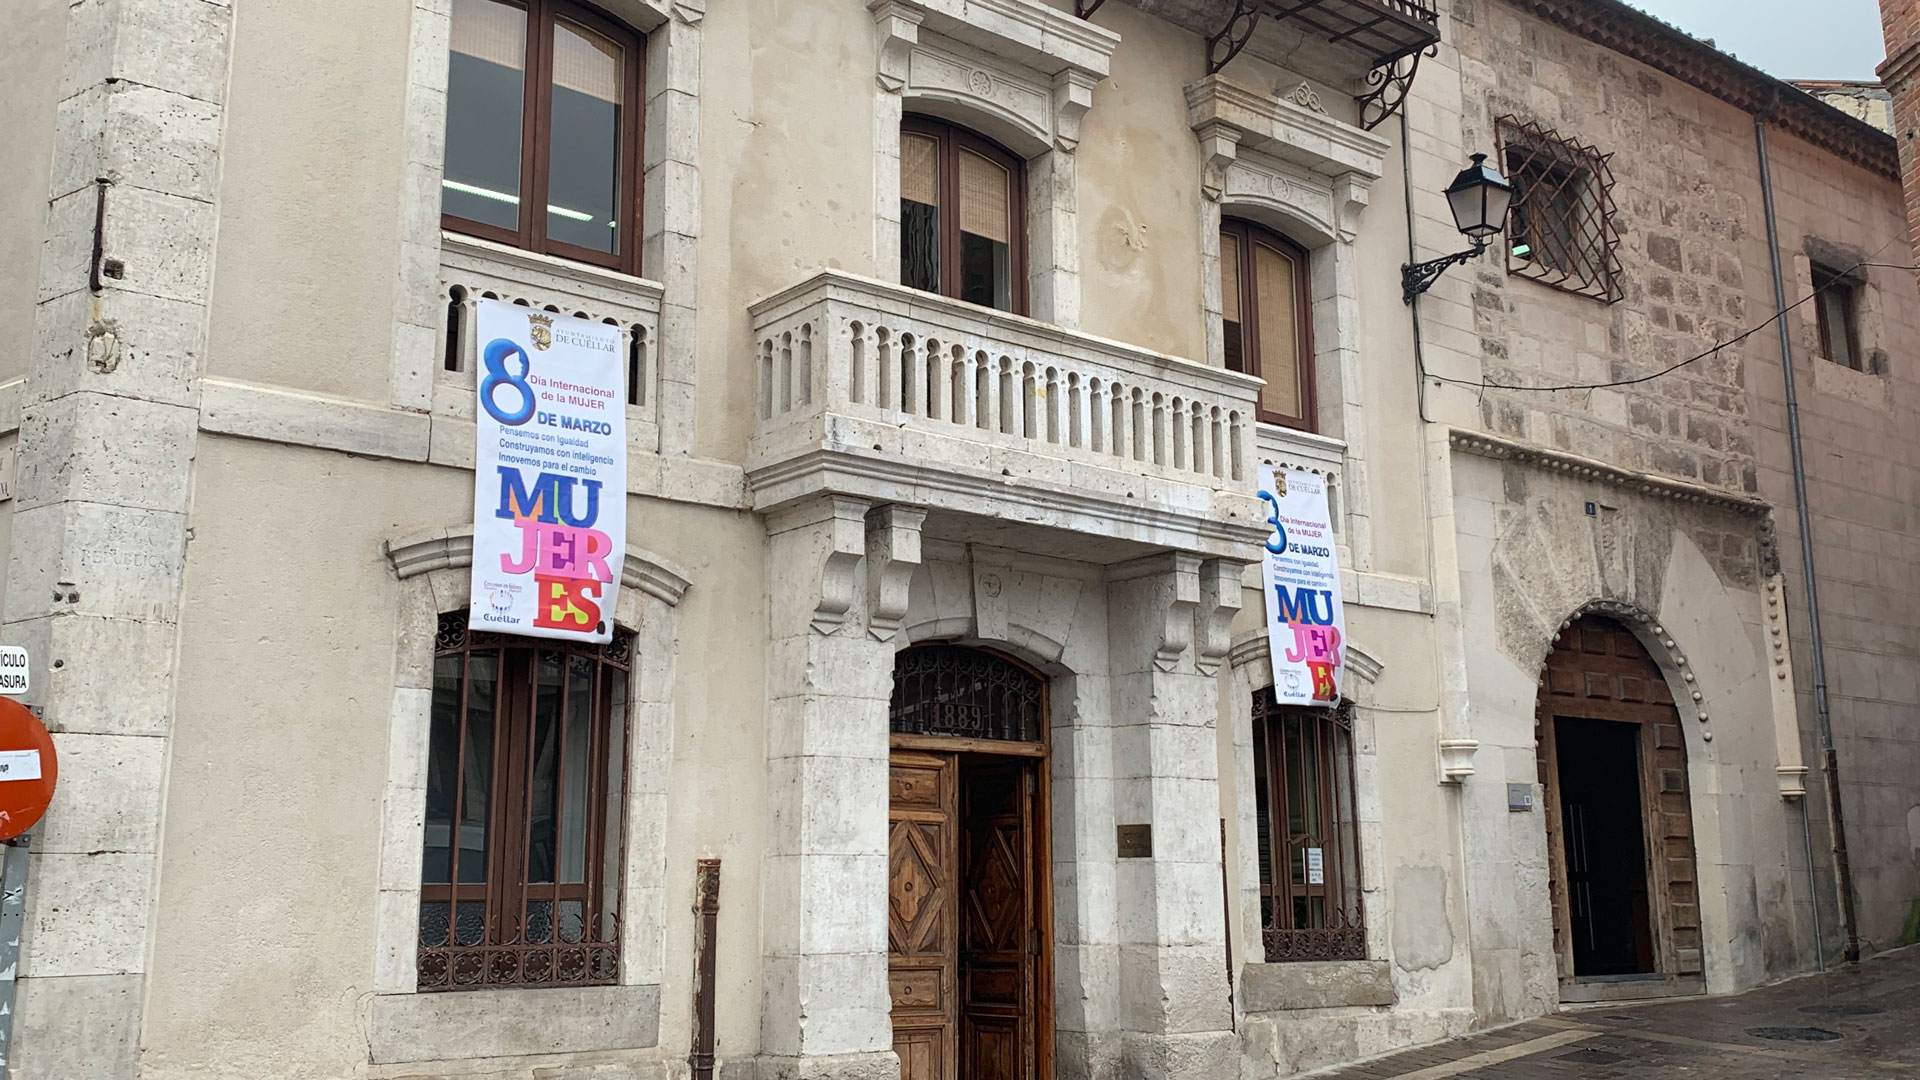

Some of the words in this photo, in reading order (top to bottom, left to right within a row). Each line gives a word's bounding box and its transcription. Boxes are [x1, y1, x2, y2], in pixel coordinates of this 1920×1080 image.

[556, 334, 570, 344] DE
[480, 337, 537, 427] 8
[530, 374, 547, 387] Día
[549, 378, 615, 399] Internacional
[541, 391, 554, 401] de
[556, 393, 566, 403] la
[568, 395, 605, 410] MUJER
[500, 425, 540, 440] Pensemos
[541, 432, 556, 443] con
[537, 411, 557, 427] DE
[561, 415, 612, 436] MARZO
[498, 452, 541, 467] Innovemos
[542, 459, 559, 471] para
[561, 462, 568, 472] el
[569, 464, 597, 476] cambio
[499, 438, 555, 455] Construyamos
[556, 449, 571, 459] con
[572, 450, 614, 466] inteligencia
[495, 465, 603, 529] MU
[1301, 529, 1322, 538] MUJER
[500, 519, 613, 584] JER
[1288, 542, 1300, 554] DE
[1300, 543, 1330, 558] MARZO
[1274, 583, 1334, 626] MU
[932, 703, 982, 730] 1889
